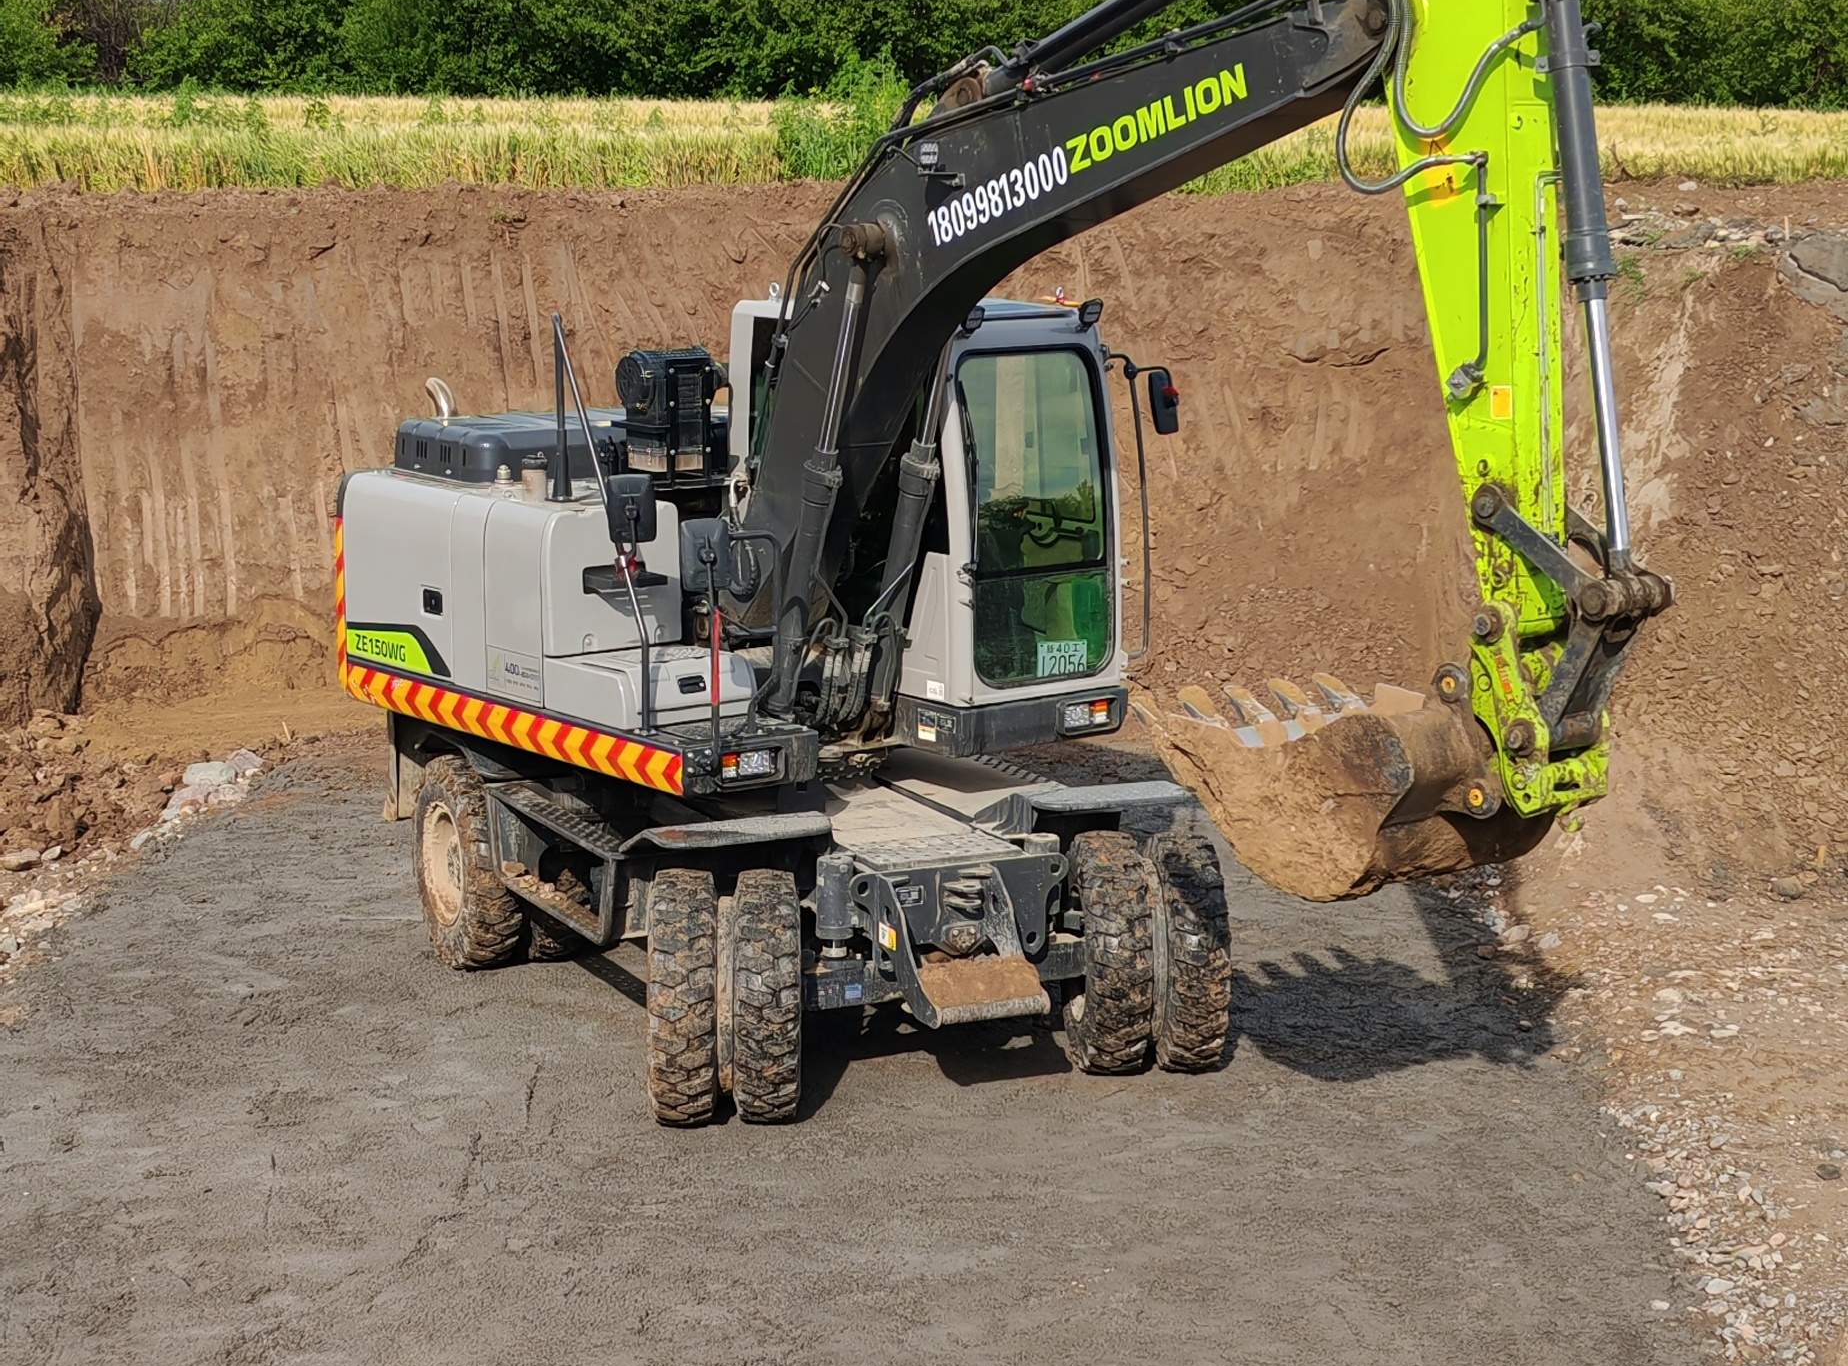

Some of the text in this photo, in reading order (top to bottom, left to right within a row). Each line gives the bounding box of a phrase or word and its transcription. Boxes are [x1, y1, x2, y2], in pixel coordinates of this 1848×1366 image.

[928, 63, 1248, 247] 18099813000 ZOOMLION
[354, 633, 406, 662] ZE150WG
[1042, 654, 1085, 675] 12056
